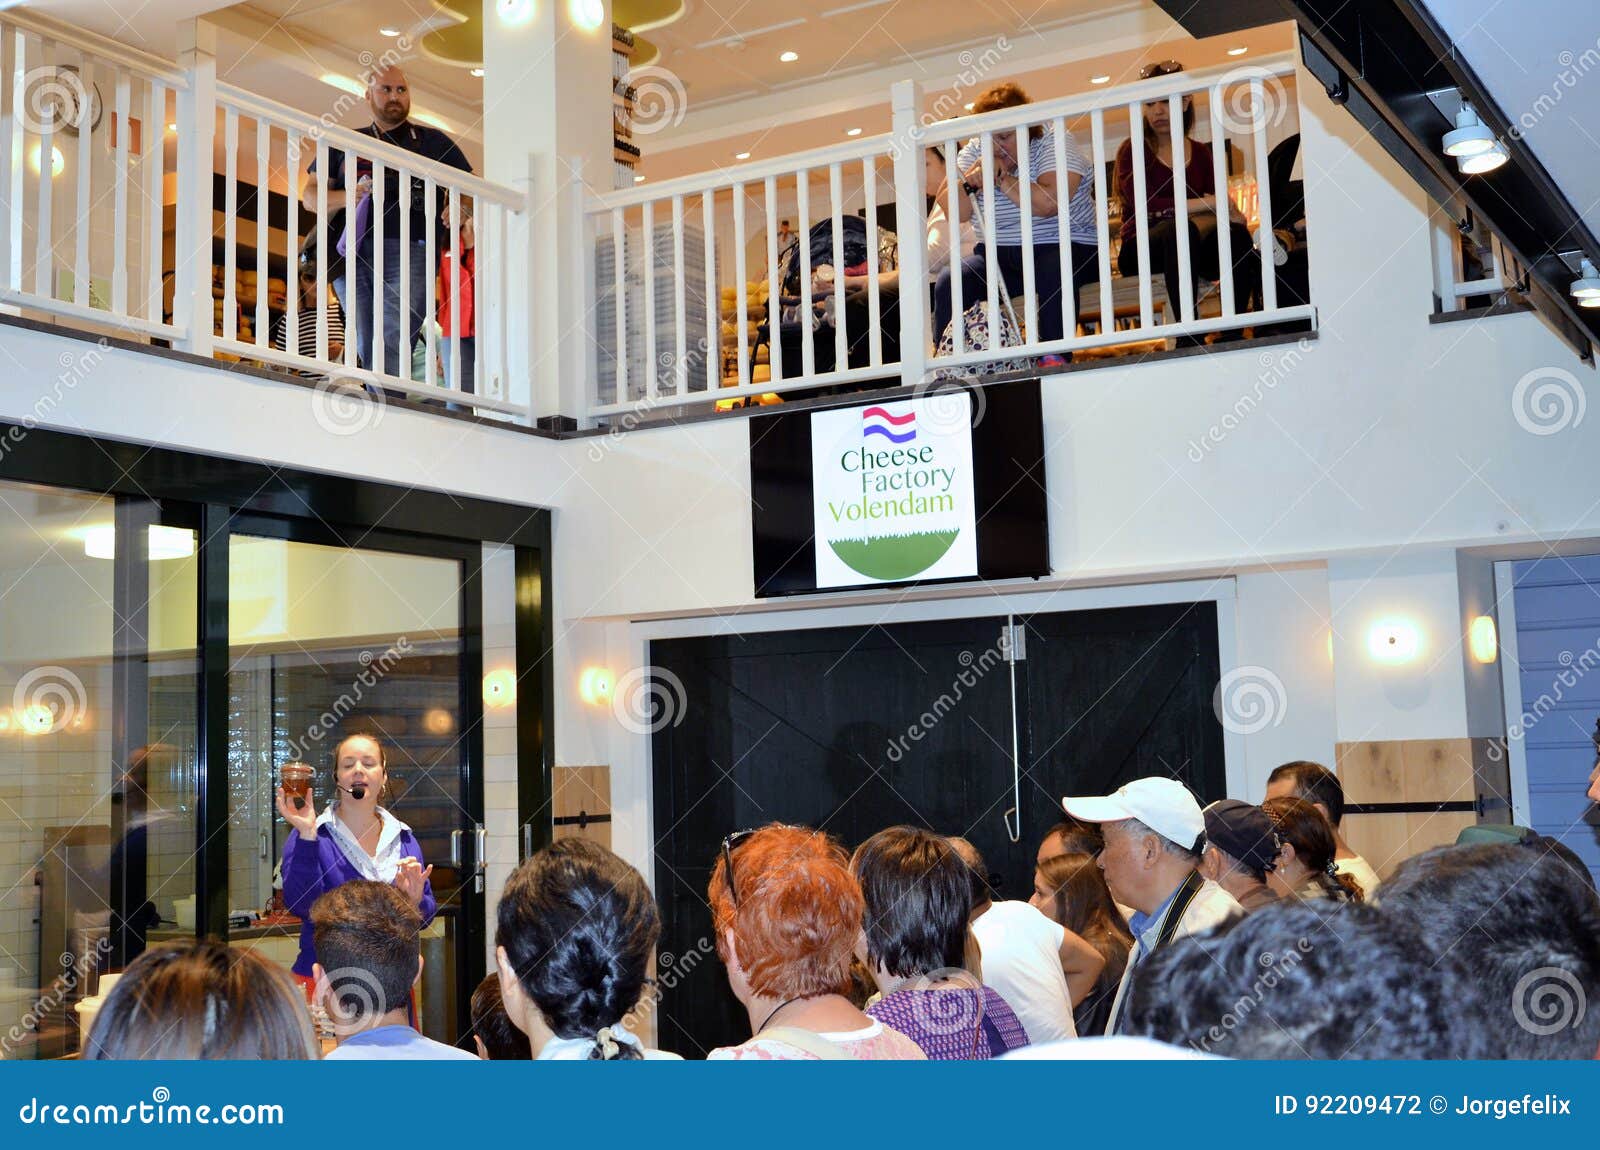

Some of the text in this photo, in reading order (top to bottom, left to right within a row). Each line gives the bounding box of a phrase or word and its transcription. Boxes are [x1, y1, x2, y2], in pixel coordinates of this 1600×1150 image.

[841, 446, 934, 472] Cheese
[862, 467, 956, 493] Factory
[828, 491, 953, 522] Volendam
